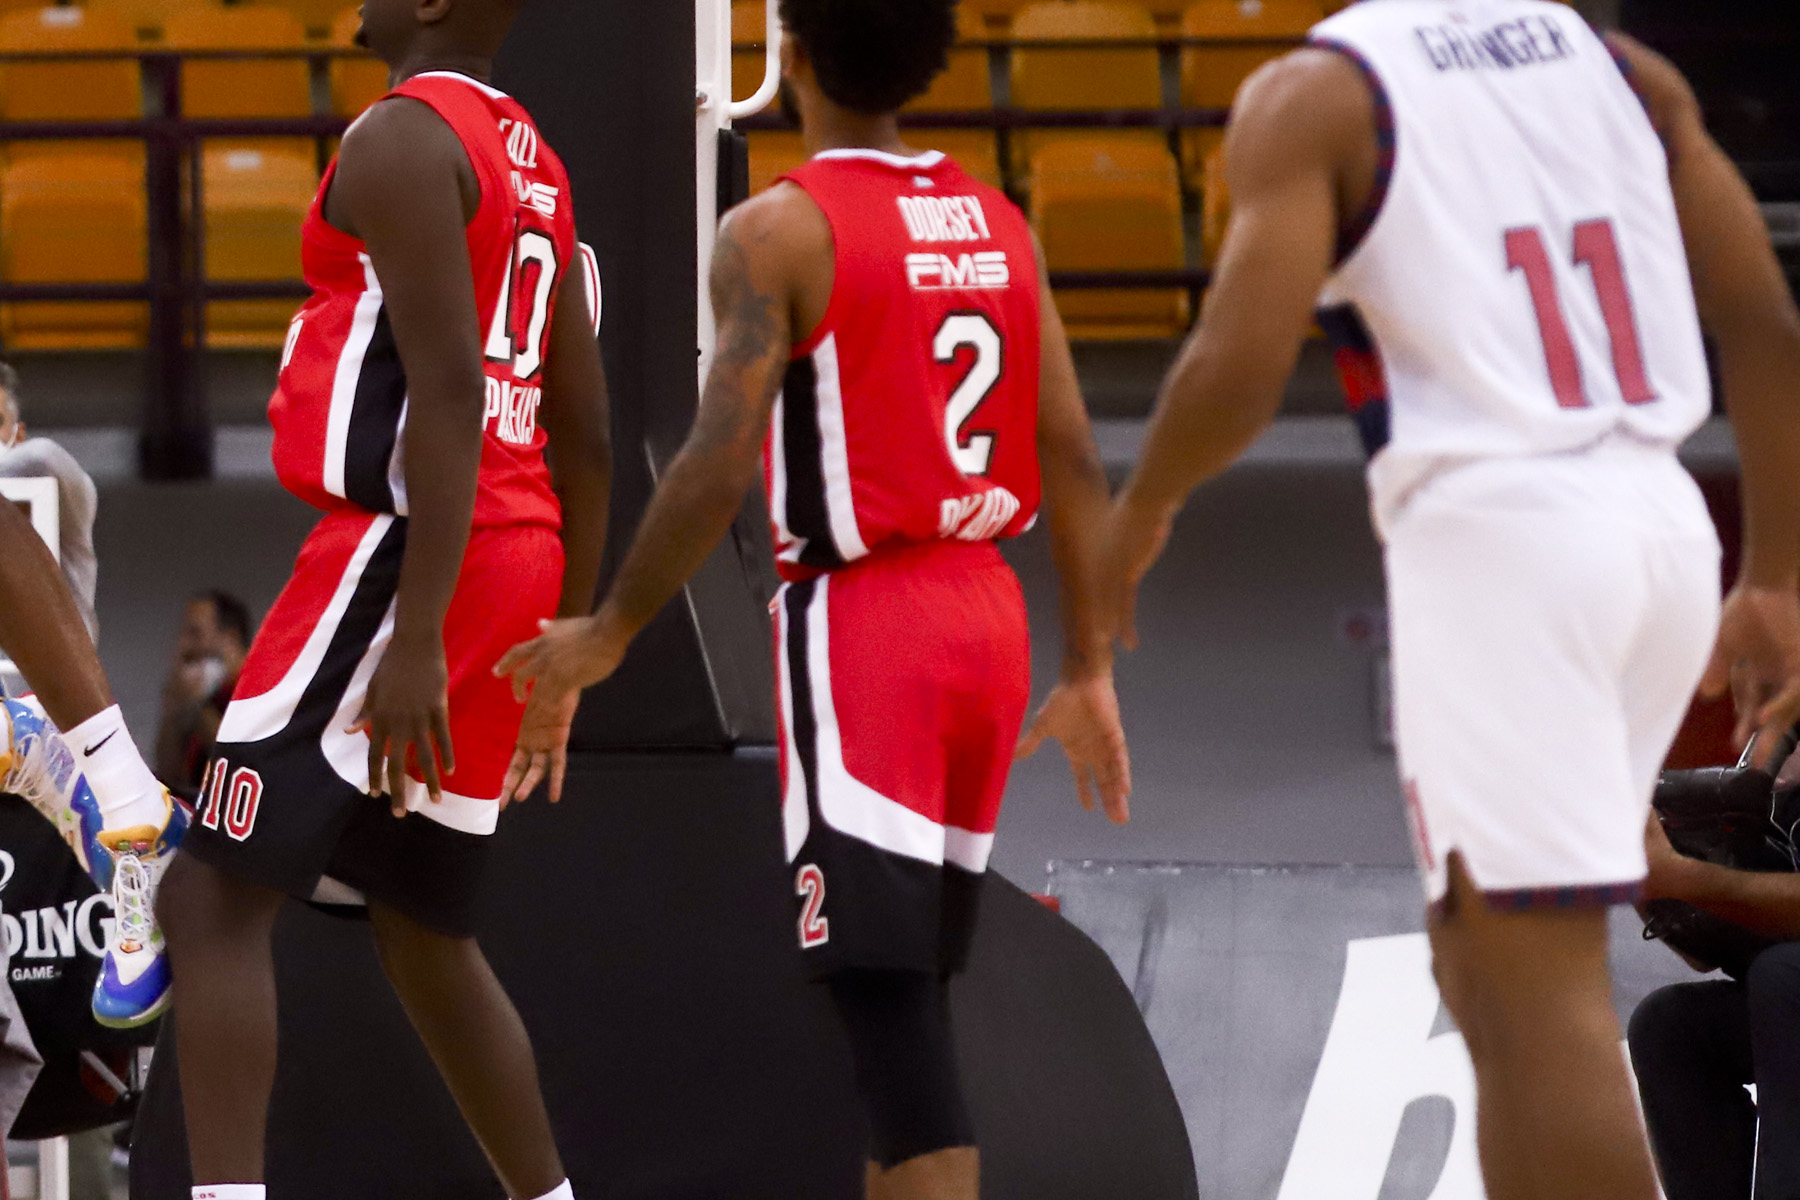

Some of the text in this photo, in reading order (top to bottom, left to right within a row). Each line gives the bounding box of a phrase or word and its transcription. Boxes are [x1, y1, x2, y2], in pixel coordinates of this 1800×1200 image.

[896, 194, 991, 242] DORSEY
[904, 251, 1010, 286] FMS
[1503, 216, 1664, 410] 11
[933, 309, 1004, 478] 2
[202, 757, 264, 842] 10
[795, 863, 829, 949] 2
